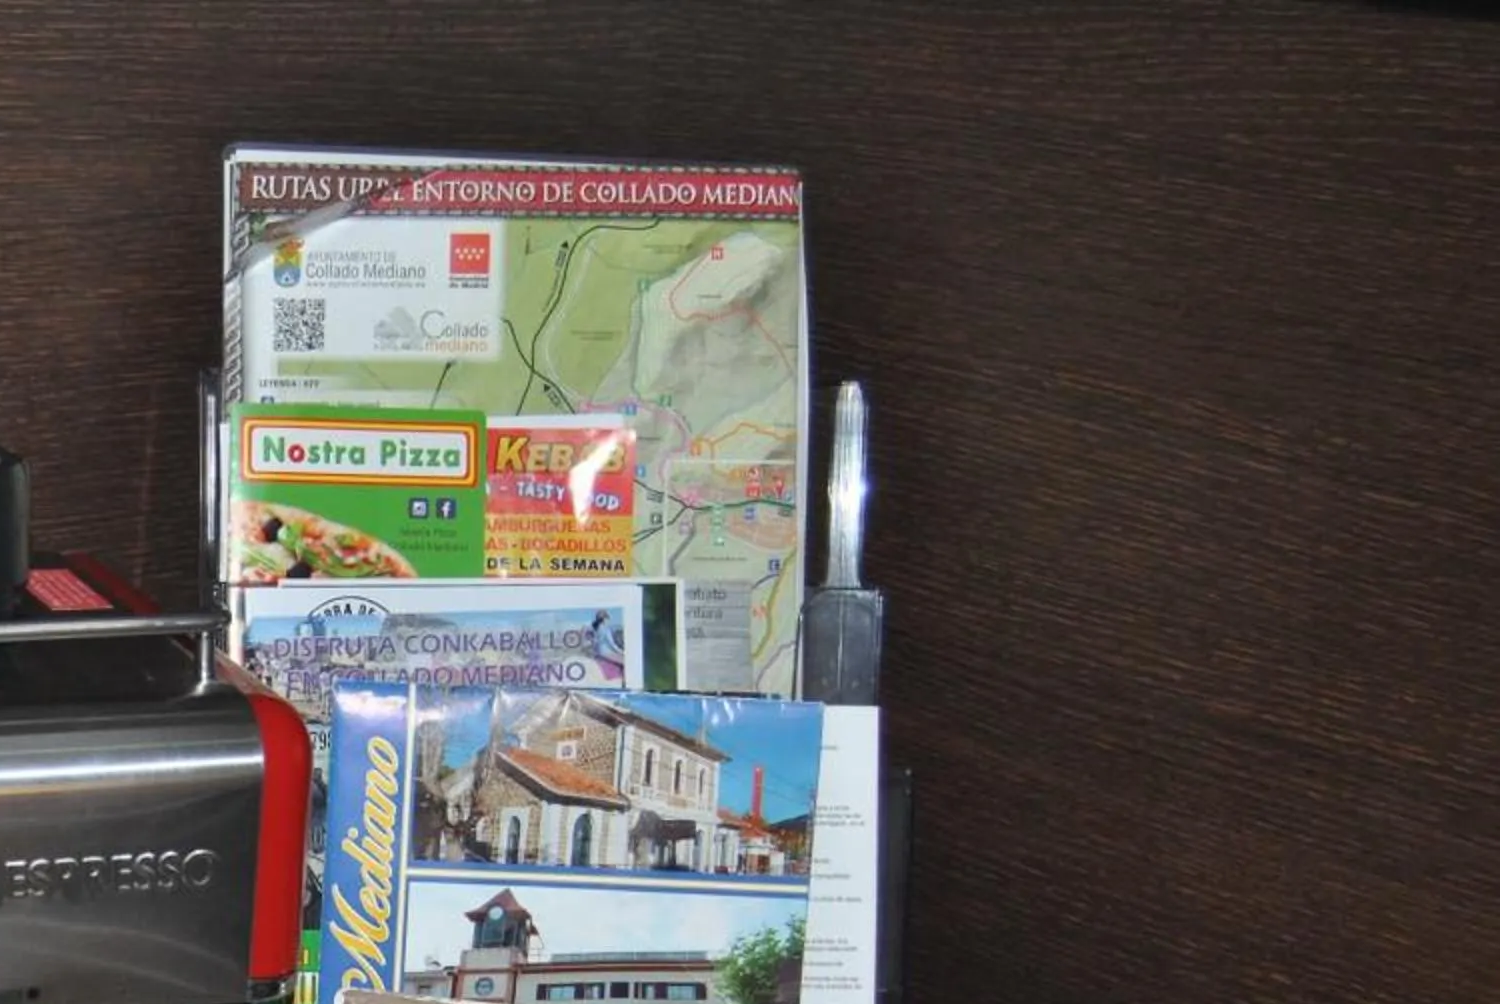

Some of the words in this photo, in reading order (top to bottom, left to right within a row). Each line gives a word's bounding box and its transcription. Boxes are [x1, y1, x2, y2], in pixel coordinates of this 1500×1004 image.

[251, 174, 332, 202] RUTAS
[413, 179, 535, 203] ENTORNO
[543, 181, 573, 203] DE
[579, 181, 697, 205] COLLADO
[305, 262, 358, 280] Collado
[363, 262, 426, 280] Mediano
[420, 309, 489, 340] Collado
[424, 338, 488, 352] mediano
[262, 435, 365, 464] Nostra
[380, 439, 461, 468] Pizza
[516, 481, 566, 502] TASTY
[521, 537, 626, 553] BOCADILLOS
[518, 557, 541, 571] LA
[550, 558, 625, 571] SEMANA
[274, 634, 395, 658] DISFRUTA
[460, 661, 586, 686] MEDIANO
[4, 848, 217, 898] ESPRESSO
[330, 735, 399, 993] Mediano
